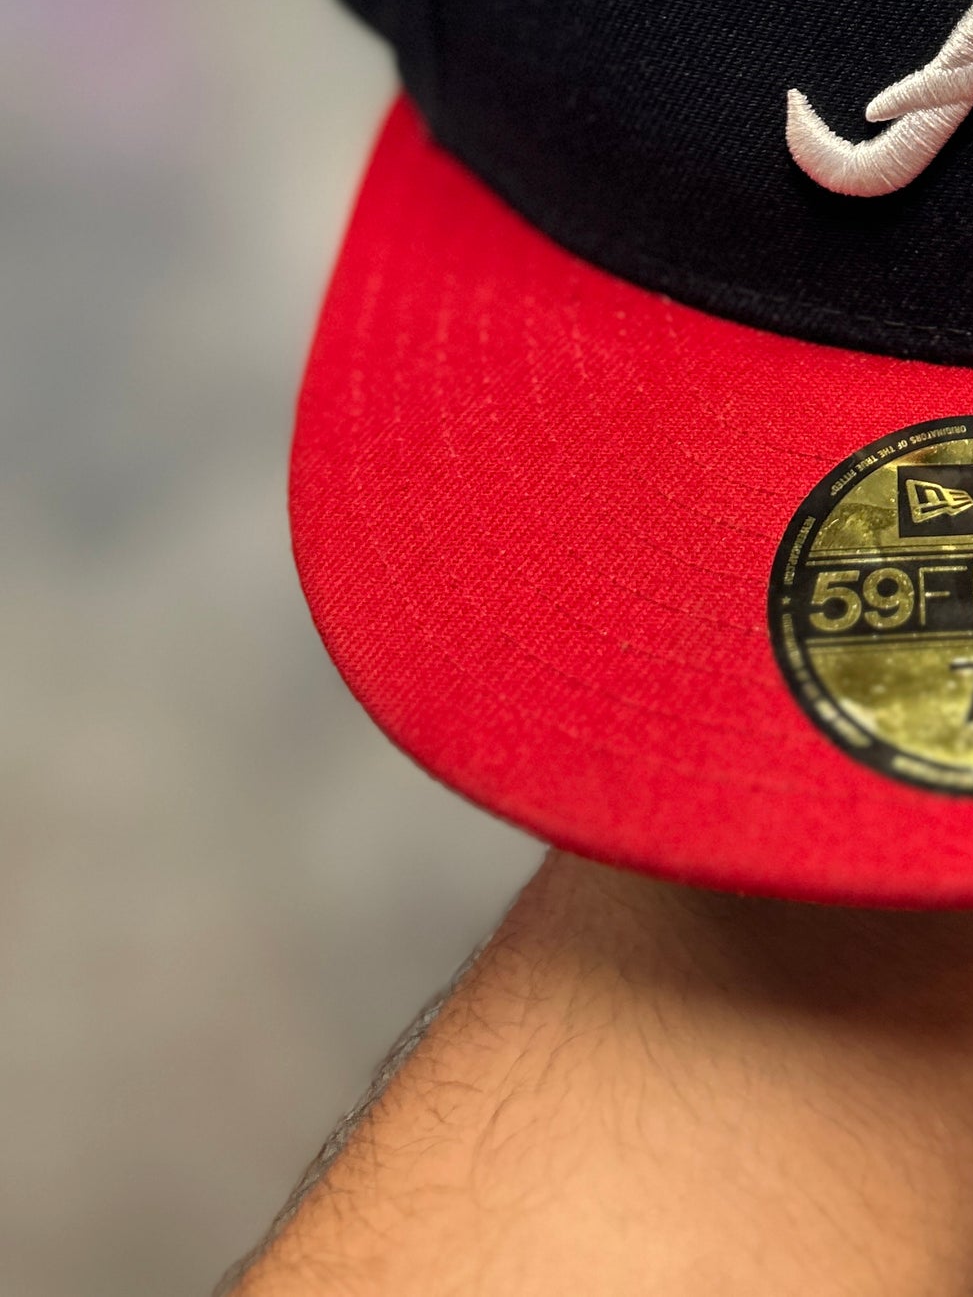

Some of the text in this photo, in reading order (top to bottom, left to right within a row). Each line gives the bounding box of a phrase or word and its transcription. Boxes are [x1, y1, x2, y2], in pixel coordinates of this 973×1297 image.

[909, 424, 967, 444] ORIGINATORS
[877, 446, 896, 458] THE
[897, 439, 908, 450] OF
[855, 454, 879, 472] TRUE
